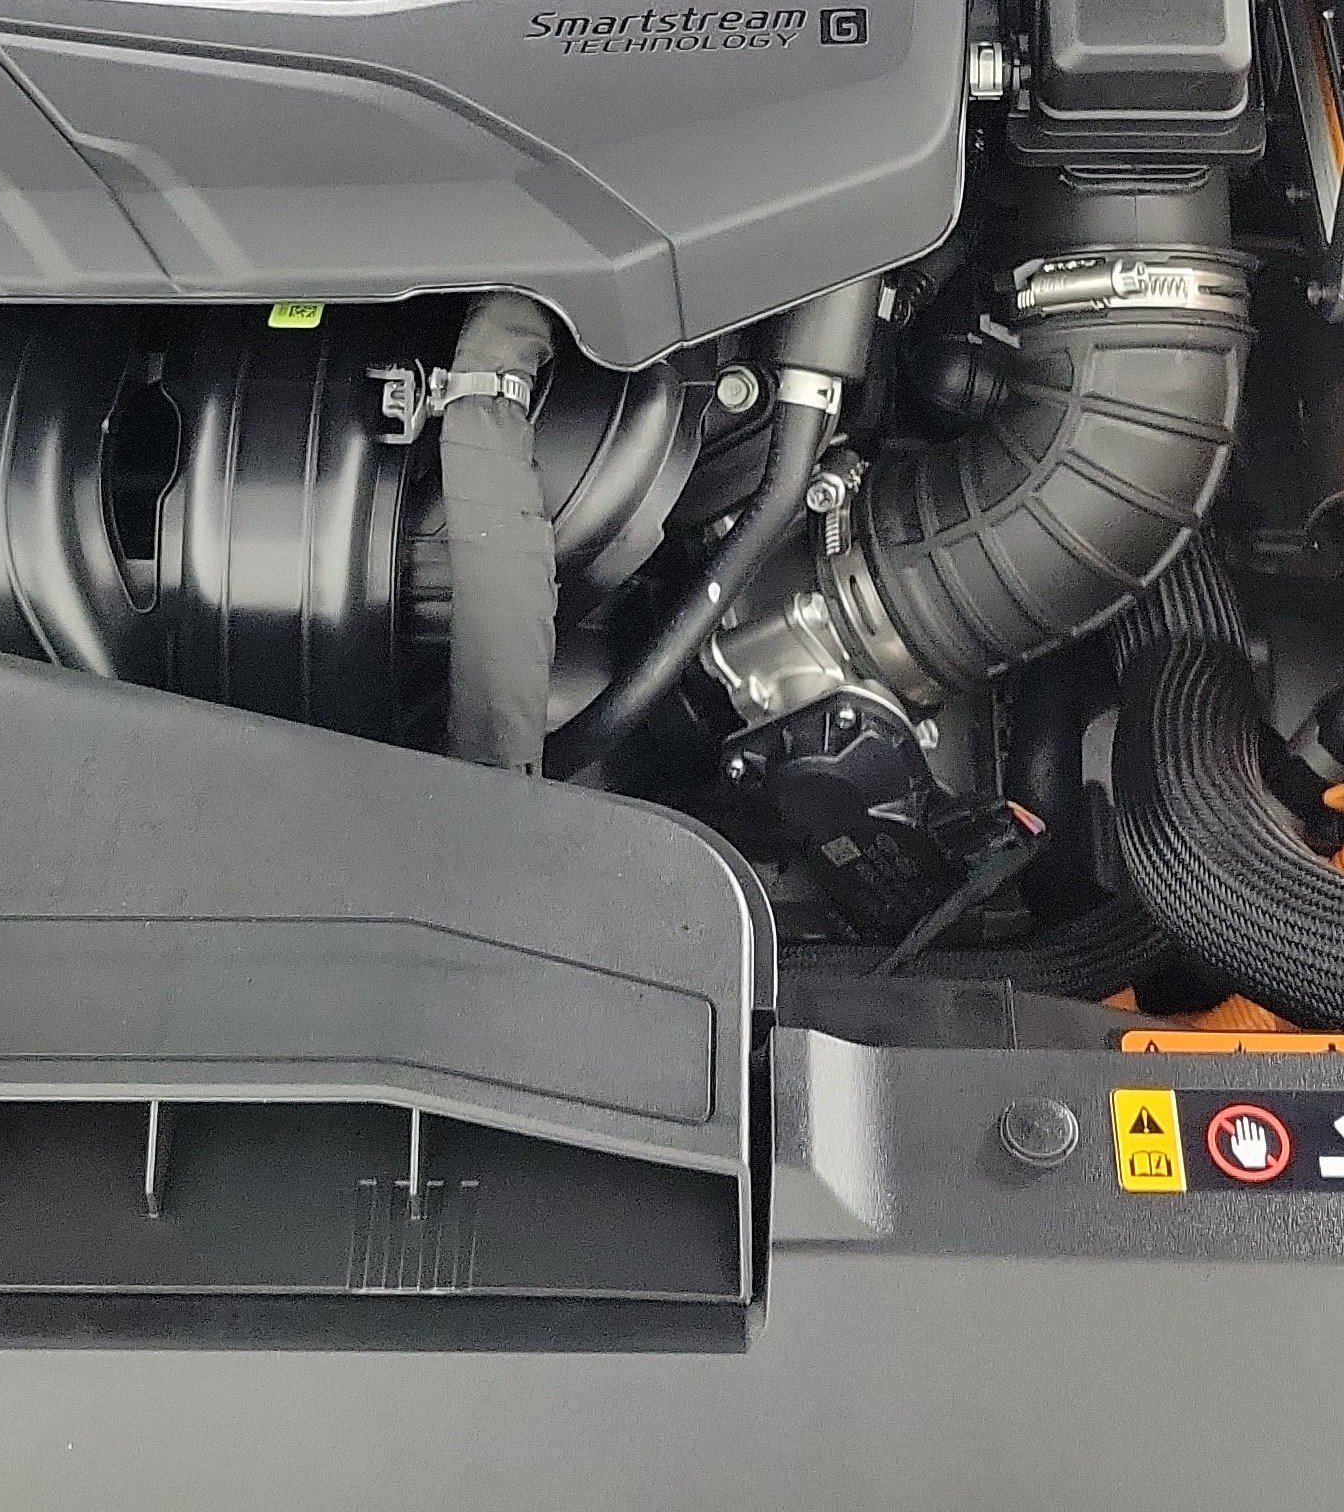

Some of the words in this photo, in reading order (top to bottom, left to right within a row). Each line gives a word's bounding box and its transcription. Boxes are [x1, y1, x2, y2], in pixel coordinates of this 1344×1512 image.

[524, 7, 808, 38] Smartstream
[826, 11, 863, 43] G
[559, 33, 798, 55] TECHNOLOGY
